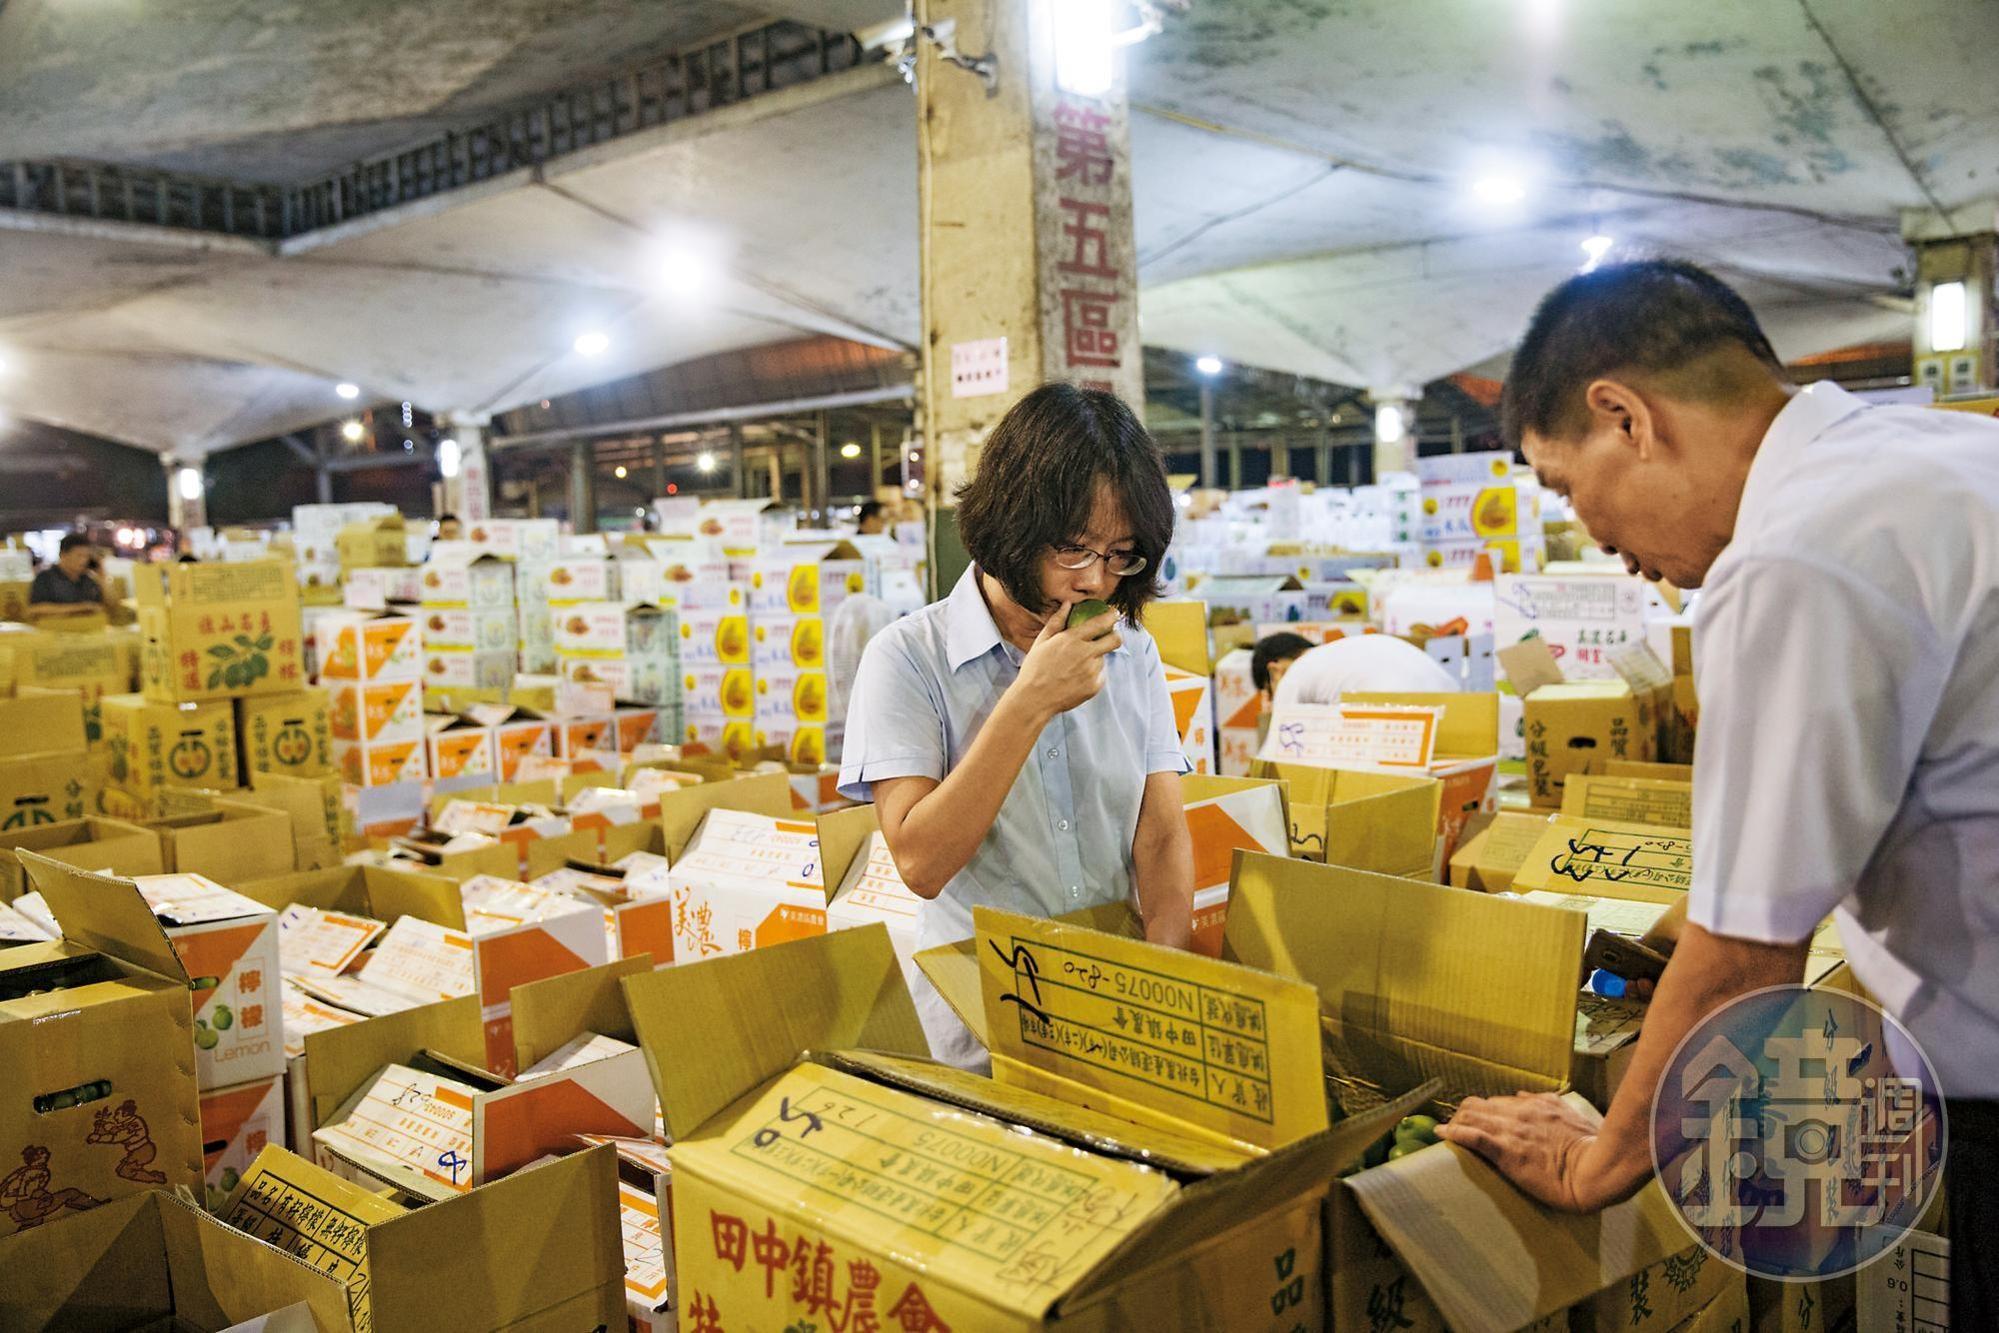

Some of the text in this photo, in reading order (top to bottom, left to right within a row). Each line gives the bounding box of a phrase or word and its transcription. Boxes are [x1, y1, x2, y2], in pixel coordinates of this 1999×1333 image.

[1053, 99, 1121, 392] 第五區
[238, 969, 263, 1030] 檸檬
[1115, 971, 1195, 1012] N00075
[1112, 1006, 1197, 1046] 田中鎮農會
[214, 1040, 271, 1063] Lemon
[912, 1130, 1001, 1175] N00075
[250, 1180, 279, 1204] 品名
[710, 1208, 953, 1333] 田中鎮農會
